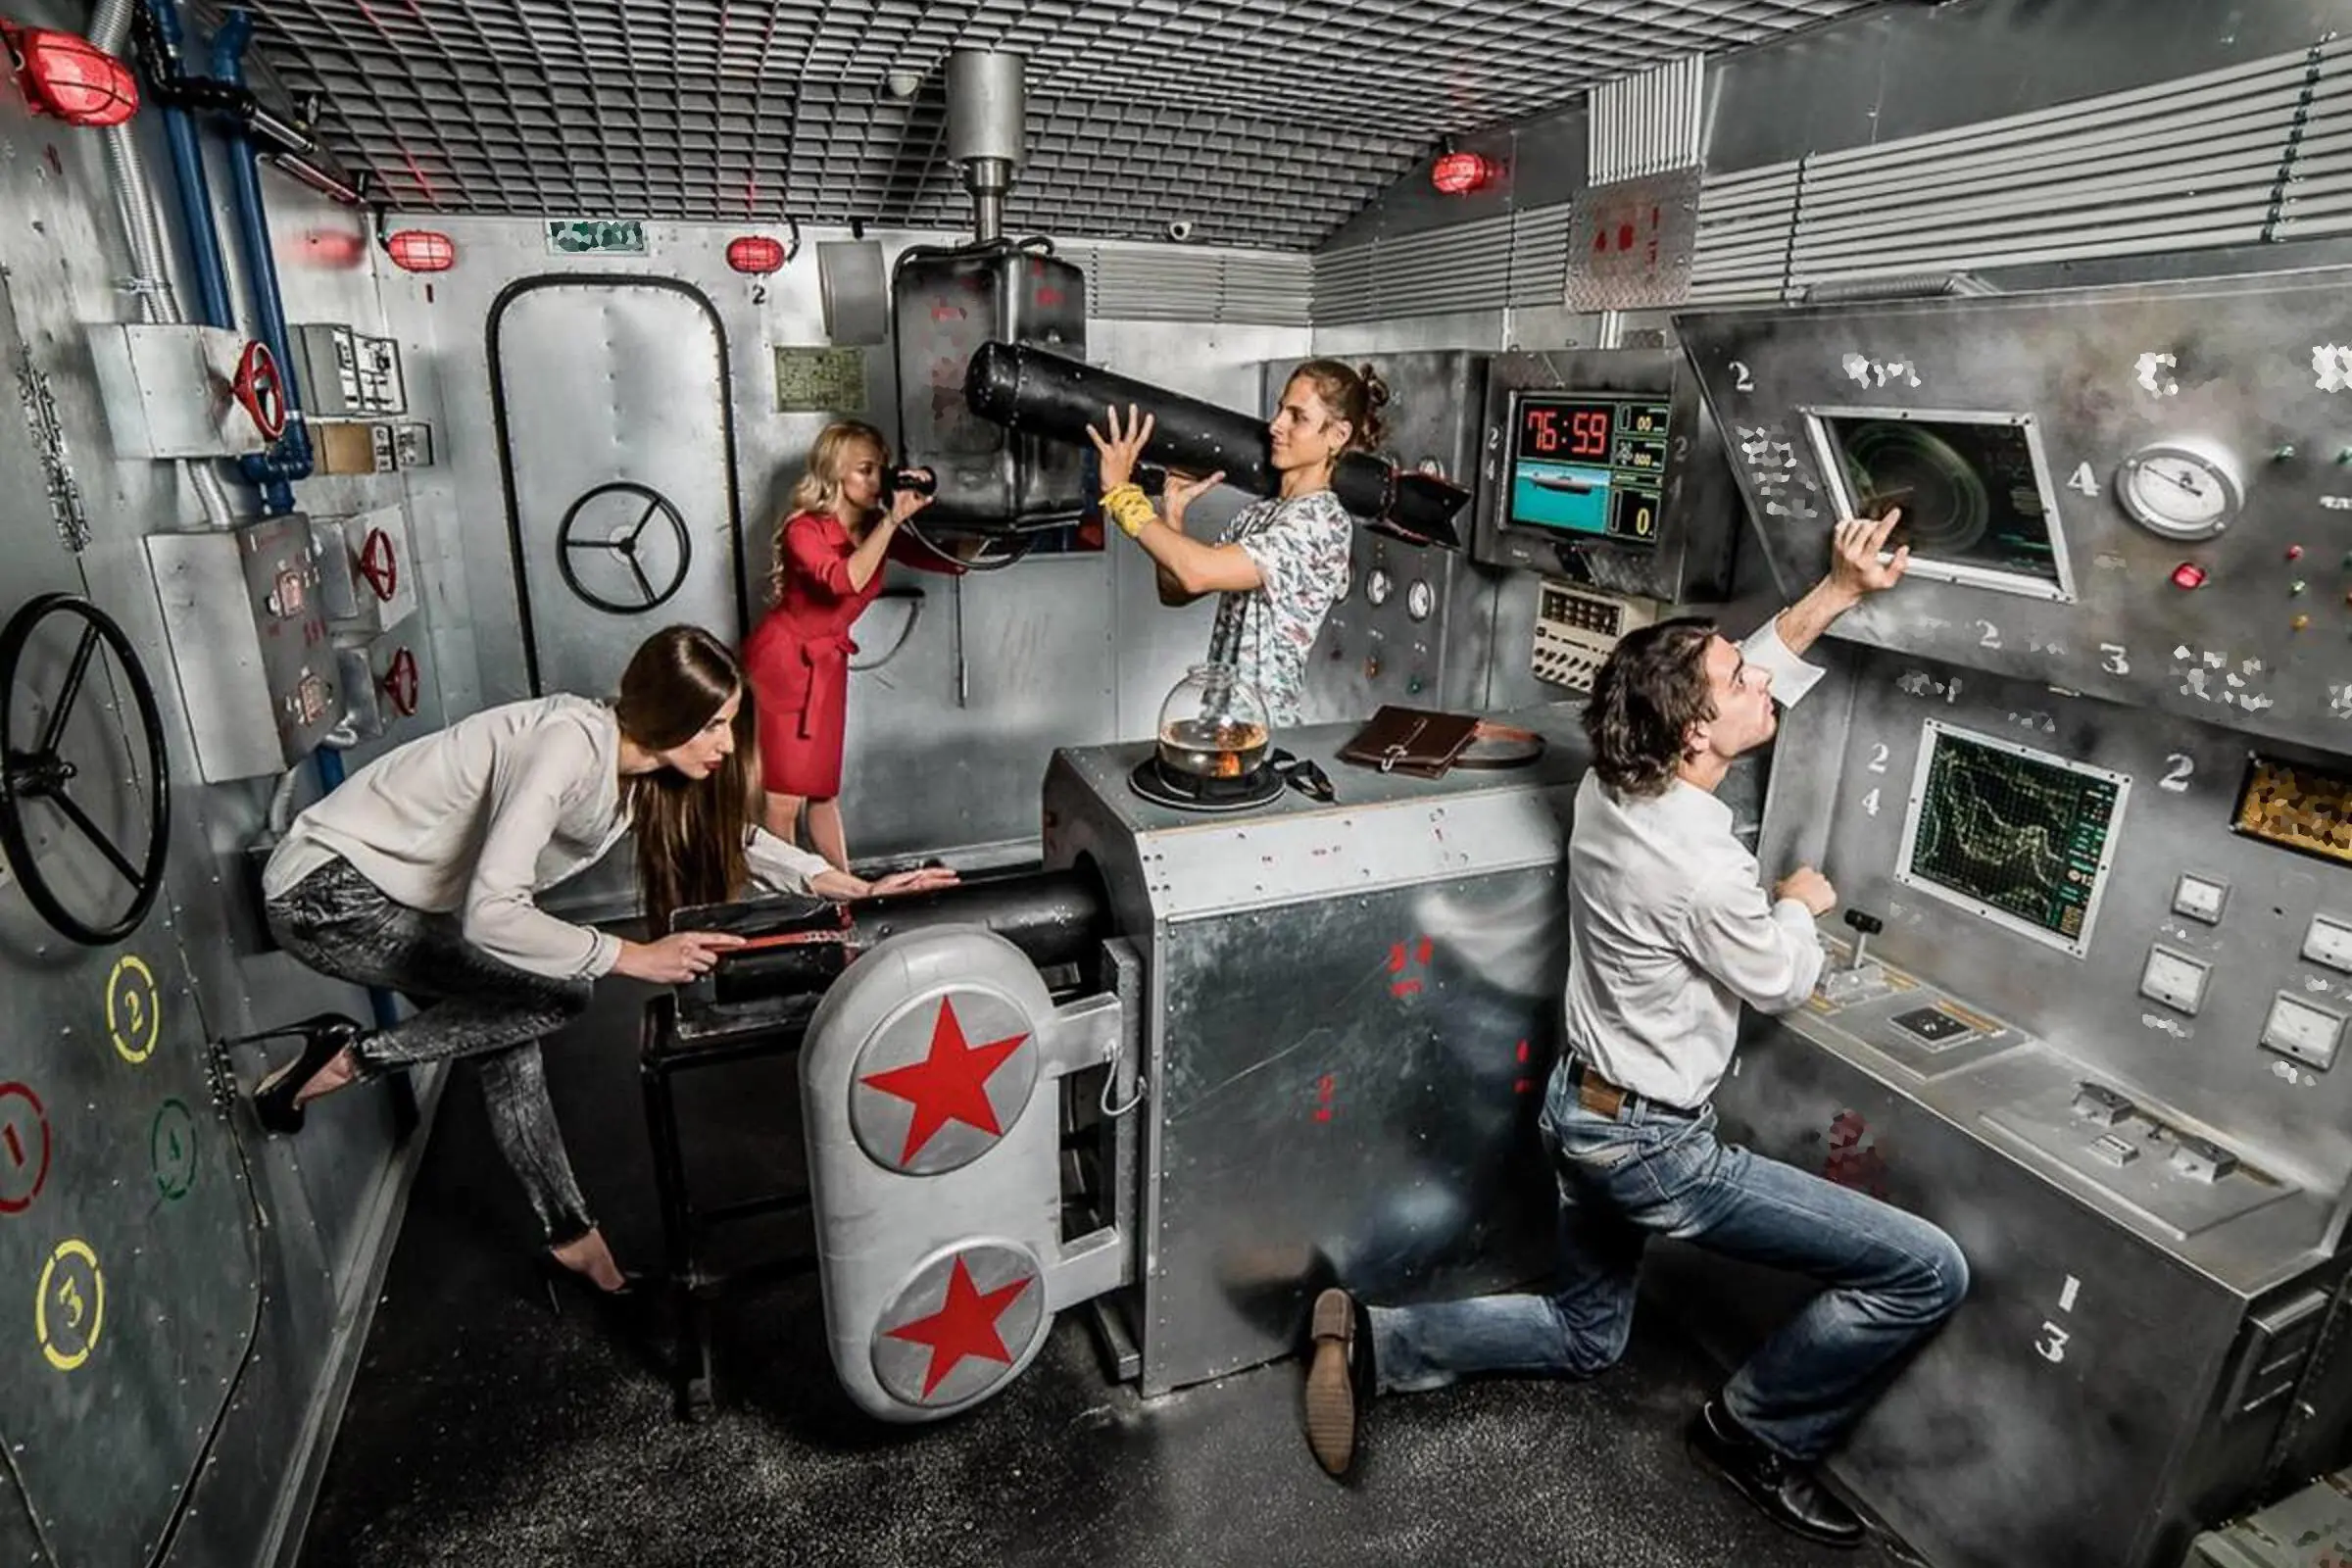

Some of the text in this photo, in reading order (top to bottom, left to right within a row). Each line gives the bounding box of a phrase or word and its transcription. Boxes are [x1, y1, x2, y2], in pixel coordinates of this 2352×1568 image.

[753, 284, 765, 305] 2
[1729, 361, 1754, 391] 2
[1488, 427, 1498, 450] 2
[1674, 436, 1688, 463] 2
[1486, 460, 1495, 480] 4
[2066, 462, 2101, 497] 4
[1976, 619, 2002, 649] 2
[2099, 643, 2130, 674] 3
[1868, 743, 1889, 773] 2
[2159, 753, 2194, 792] 2
[1862, 788, 1881, 816] 4
[124, 990, 144, 1033] 2
[2, 1123, 24, 1168] 1
[59, 1275, 83, 1328] 3
[2058, 1273, 2081, 1312] 1
[2034, 1320, 2070, 1363] 3
